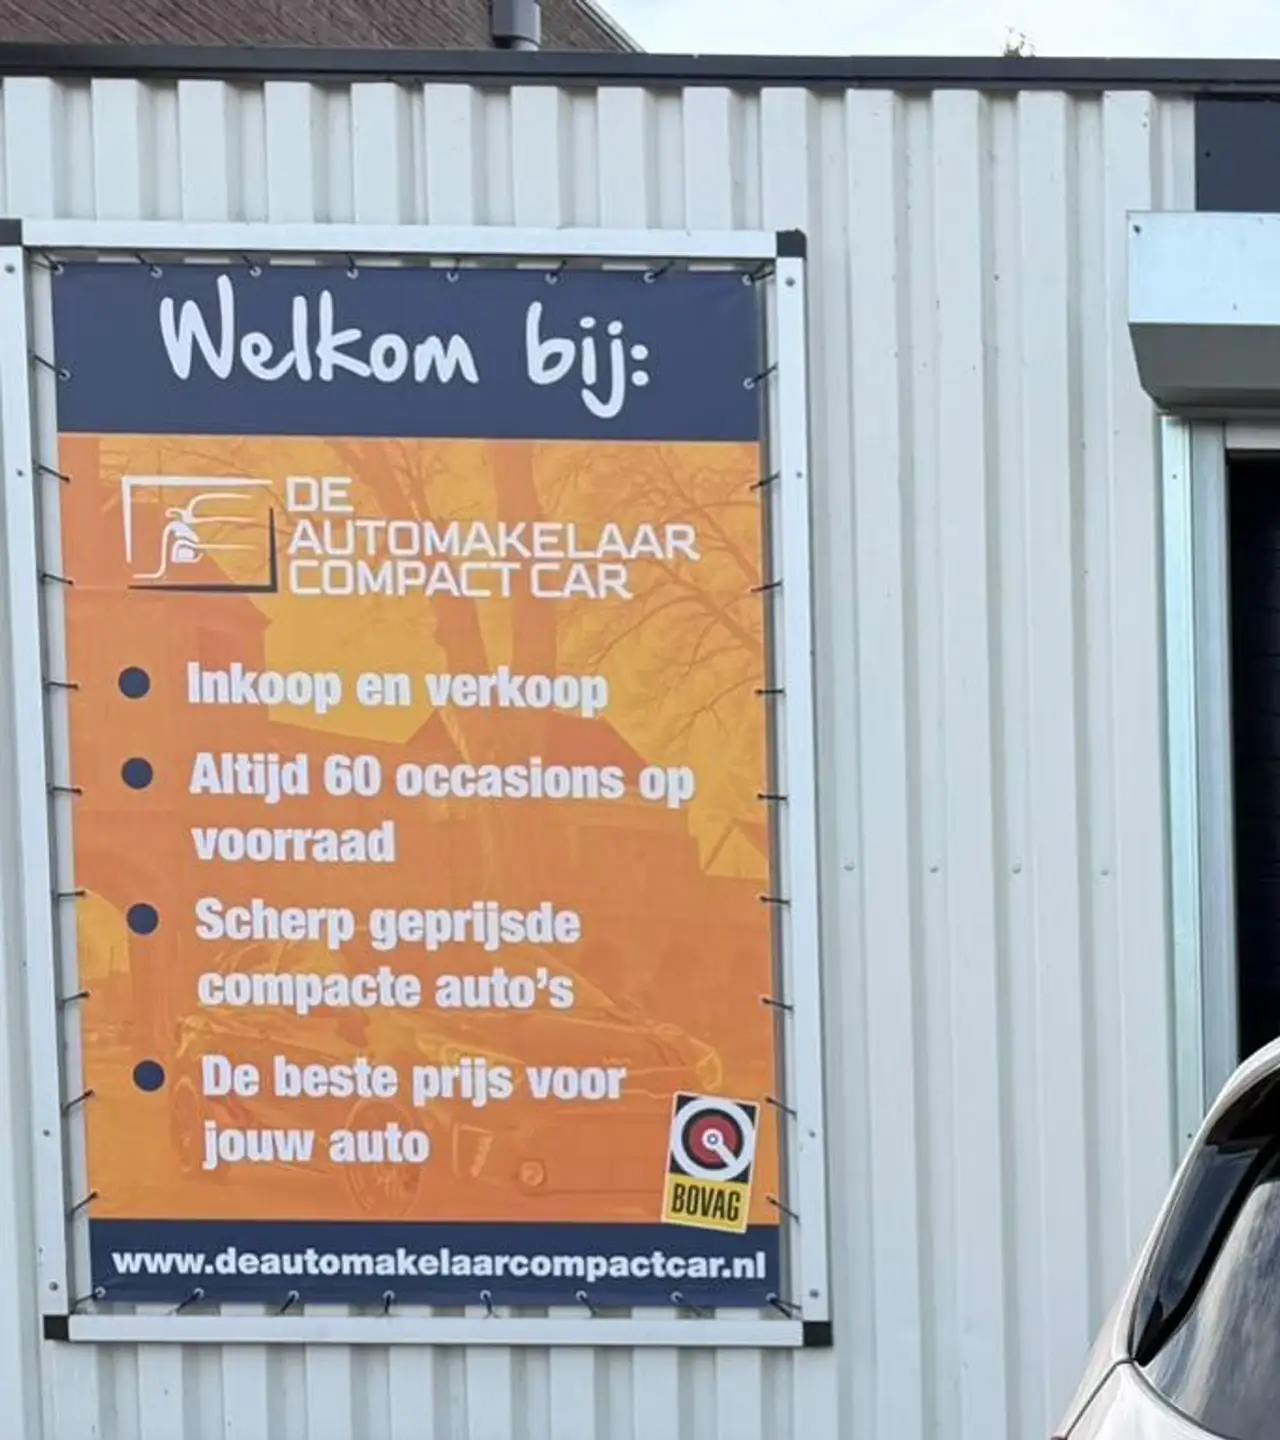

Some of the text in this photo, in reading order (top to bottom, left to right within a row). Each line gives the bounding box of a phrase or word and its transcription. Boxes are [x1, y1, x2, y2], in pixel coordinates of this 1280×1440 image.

[160, 275, 650, 419] Welkom bij:
[287, 477, 353, 513] DE
[287, 519, 700, 561] AUTOMAKELAAR
[289, 559, 634, 600] COMPACT CAR
[187, 661, 610, 717] Inkoop en verkoop
[190, 752, 695, 807] Altijd 60 occasions op
[192, 821, 395, 864] voorraad
[195, 897, 581, 952] Scherp geprijsde
[197, 966, 575, 1015] compacte auto's
[202, 1054, 627, 1108] De beste prijs voor
[202, 1121, 430, 1170] jouw auto
[672, 1181, 742, 1223] BOVAG
[112, 1248, 767, 1283] www.deautomakelaarcompactcar.nl
